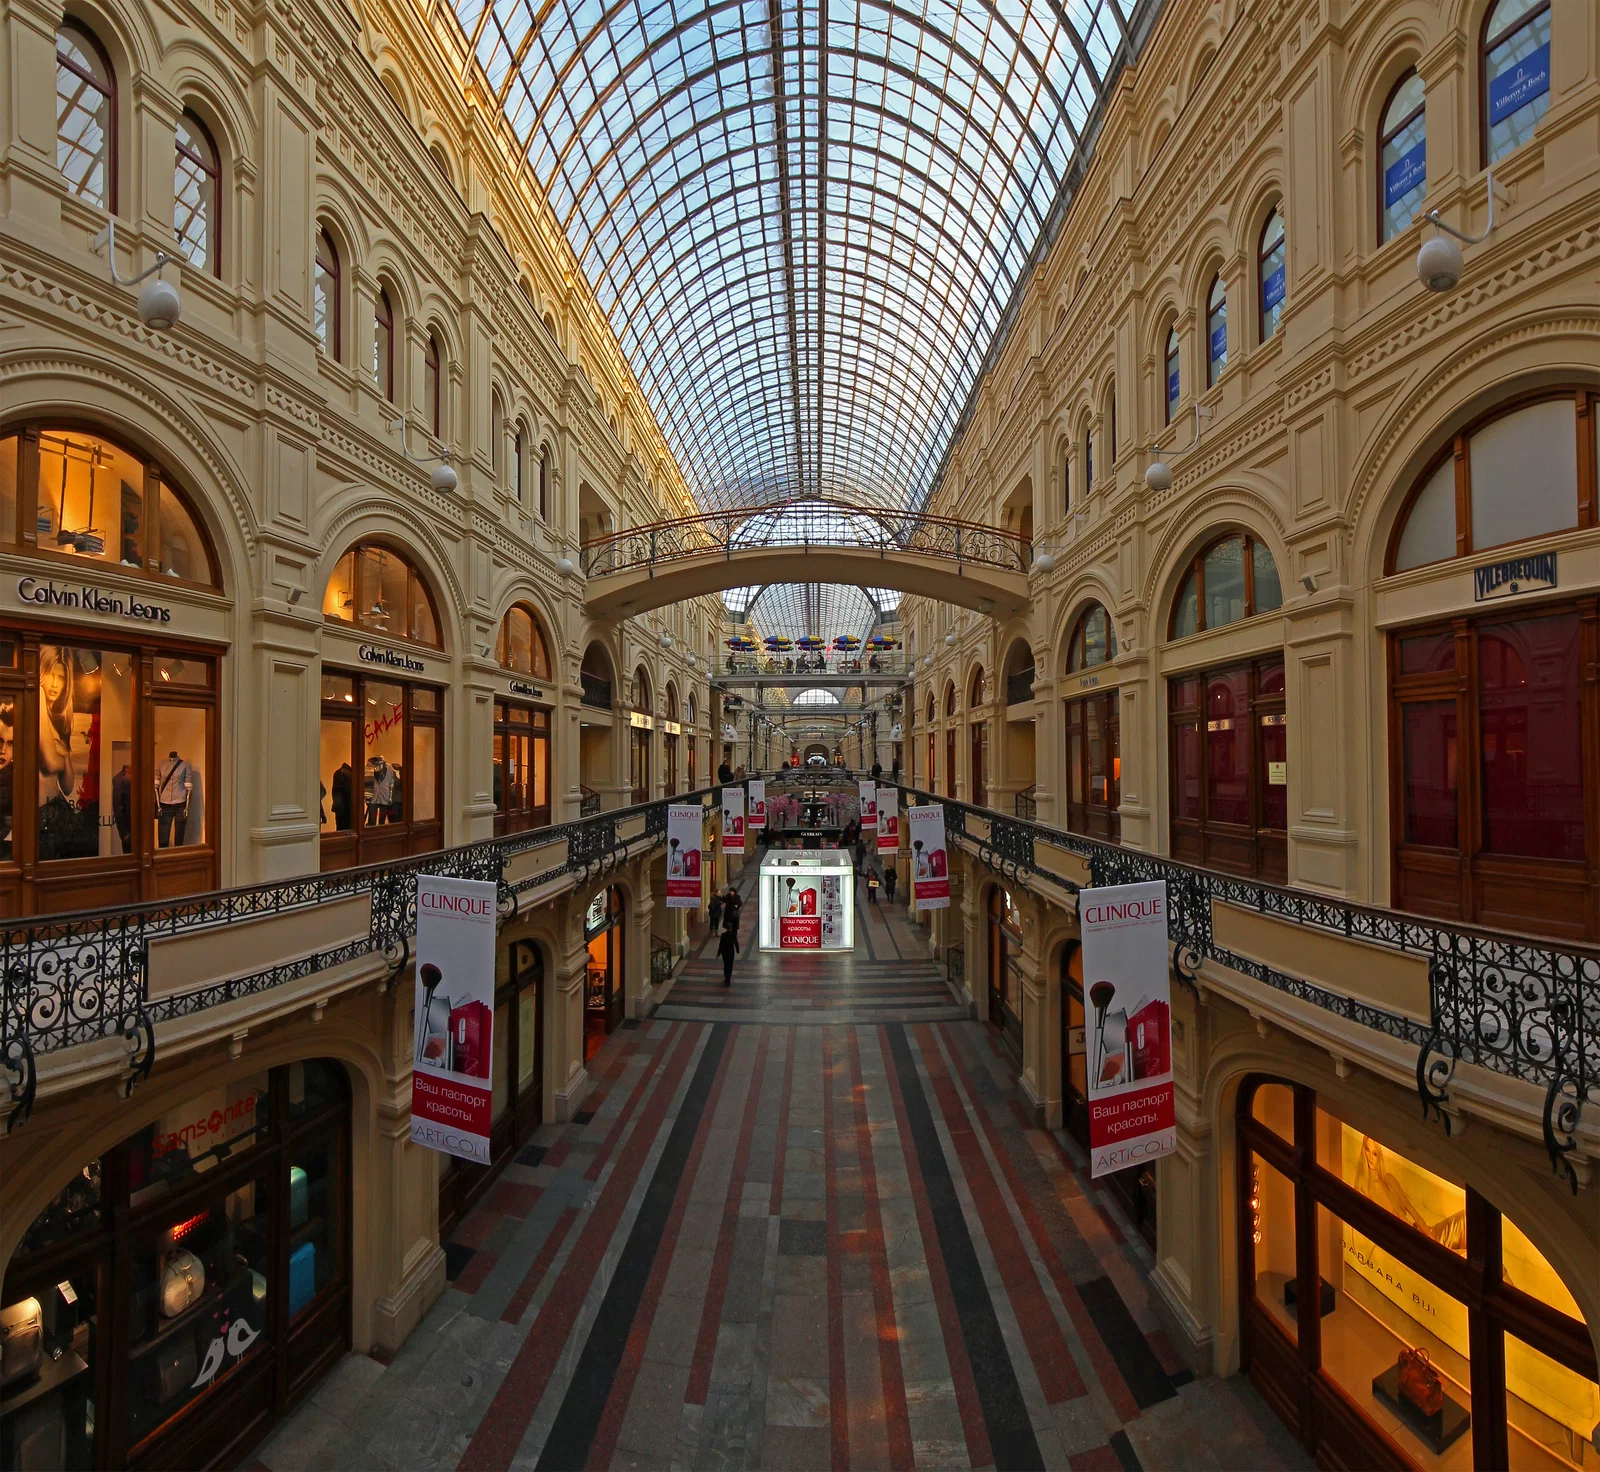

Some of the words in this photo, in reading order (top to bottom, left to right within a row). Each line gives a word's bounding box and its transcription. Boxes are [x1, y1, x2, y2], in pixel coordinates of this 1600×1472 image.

[1496, 88, 1521, 107] Villeroy
[1528, 71, 1546, 87] Boch
[1476, 552, 1554, 598] VILEBREQUIN
[18, 577, 79, 607] Calvin
[82, 587, 123, 614] Klein
[124, 595, 171, 622] Jeans
[364, 703, 402, 744] SALE
[911, 811, 942, 820] CLINIQUE
[421, 892, 491, 916] CLINIQUE
[1085, 899, 1162, 924] CLINIQUE
[782, 935, 819, 944] CLINIQUE
[415, 1077, 439, 1095] Ваш
[441, 1088, 487, 1108] паспорт
[1093, 1104, 1120, 1119] Ваш
[1122, 1092, 1170, 1112] паспорт
[426, 1100, 475, 1122] красоты.
[1107, 1113, 1159, 1135] красоты.
[151, 1095, 256, 1160] Samsonite
[415, 1125, 487, 1159] ARTICOLI
[1096, 1135, 1173, 1170] ARTICOLI
[1341, 1239, 1404, 1292] BARBARA
[1412, 1293, 1436, 1316] BUI
